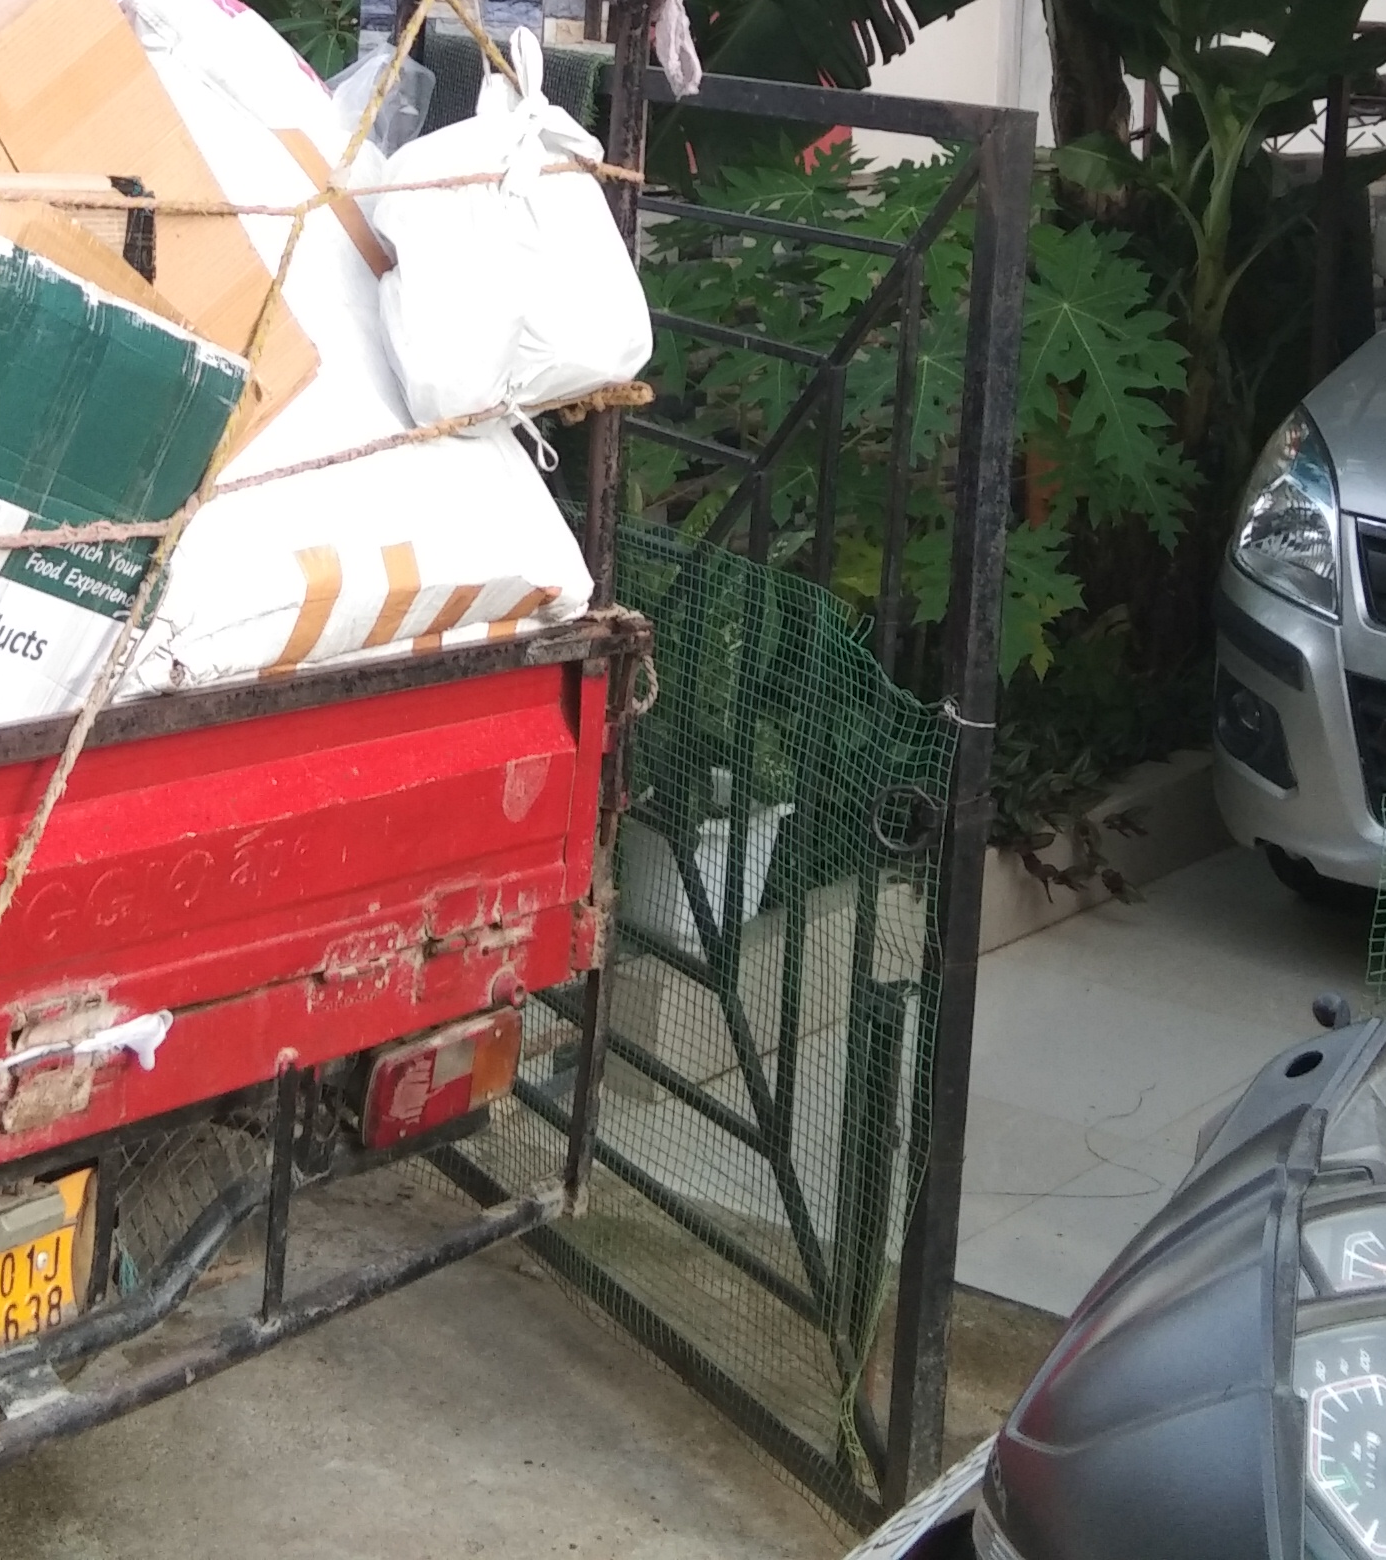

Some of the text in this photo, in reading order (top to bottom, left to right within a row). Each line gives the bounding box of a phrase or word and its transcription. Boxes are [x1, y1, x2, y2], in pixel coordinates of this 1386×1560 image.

[24, 552, 137, 609] Food Experienc
[106, 548, 143, 578] Your
